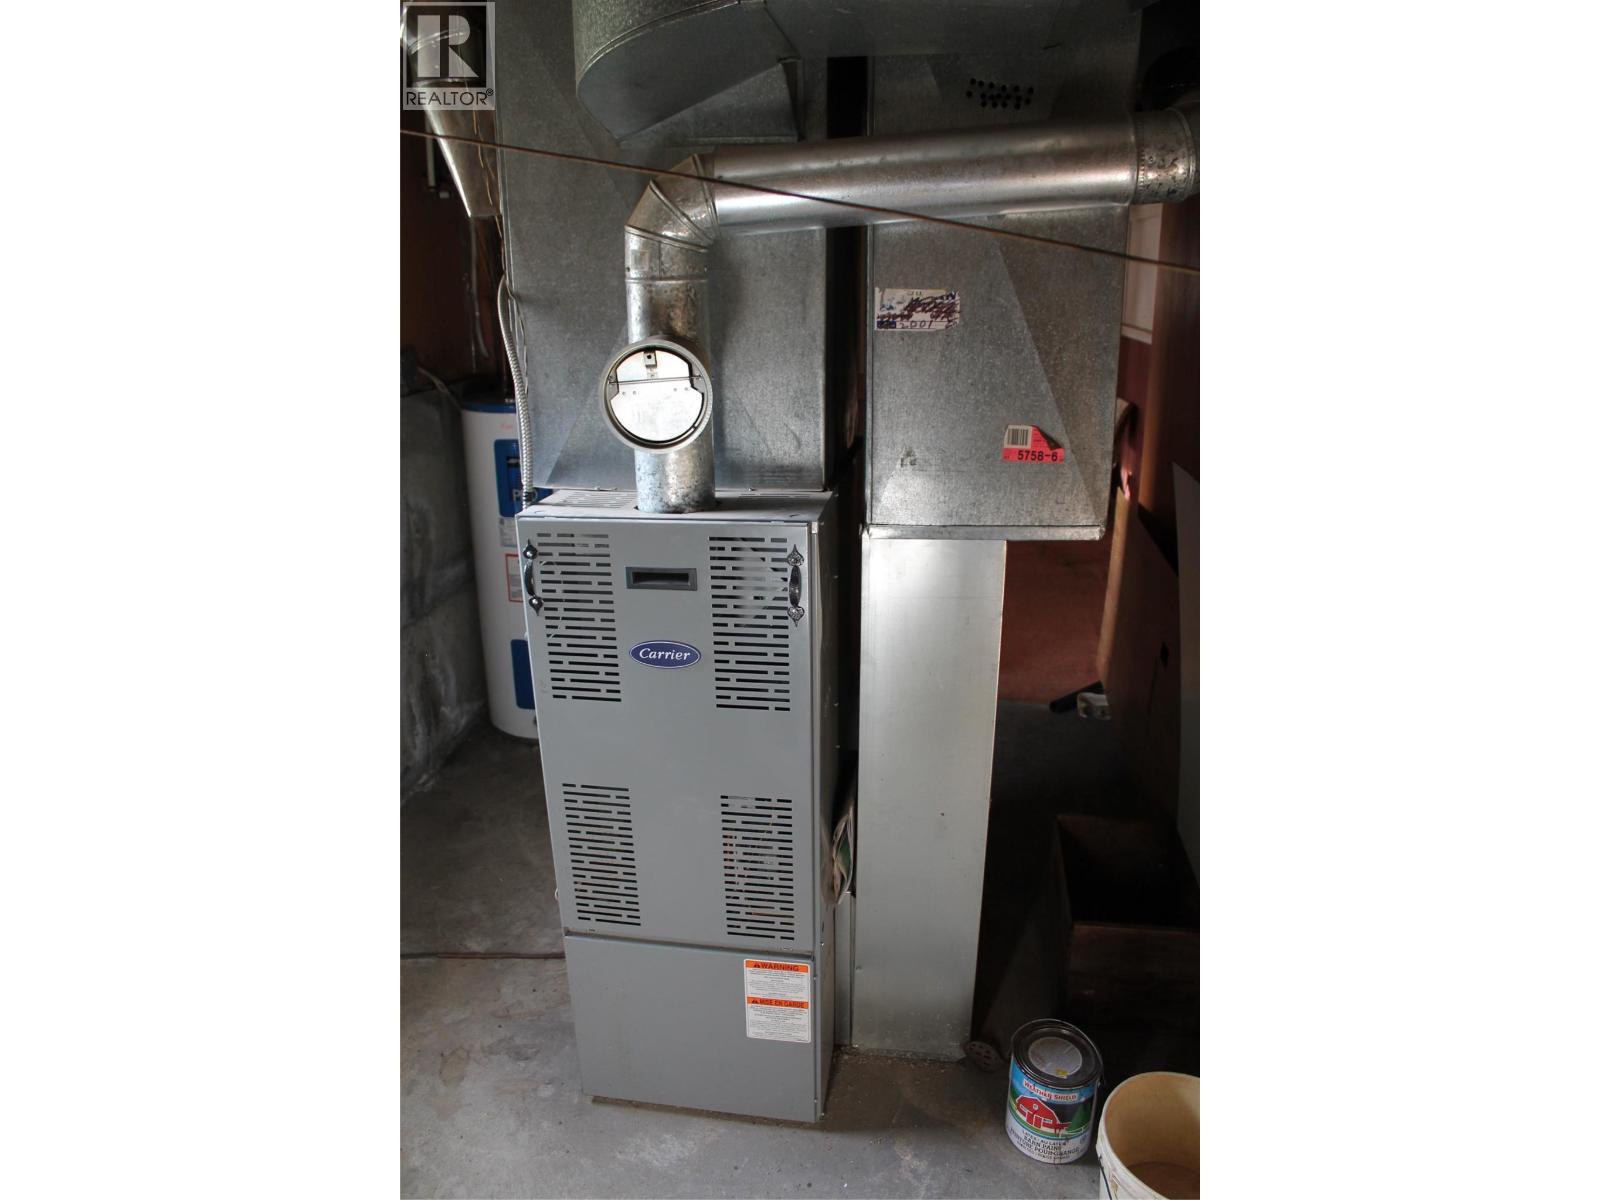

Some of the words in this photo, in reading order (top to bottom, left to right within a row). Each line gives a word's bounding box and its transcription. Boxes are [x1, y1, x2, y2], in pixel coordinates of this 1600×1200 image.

[1017, 449, 1058, 462] 5758-6
[639, 647, 691, 661] Carrier
[761, 962, 799, 971] WARNING
[760, 997, 773, 1006] MISE
[775, 999, 784, 1007] EN
[784, 1001, 805, 1009] GARDE
[1023, 1135, 1041, 1148] BARN
